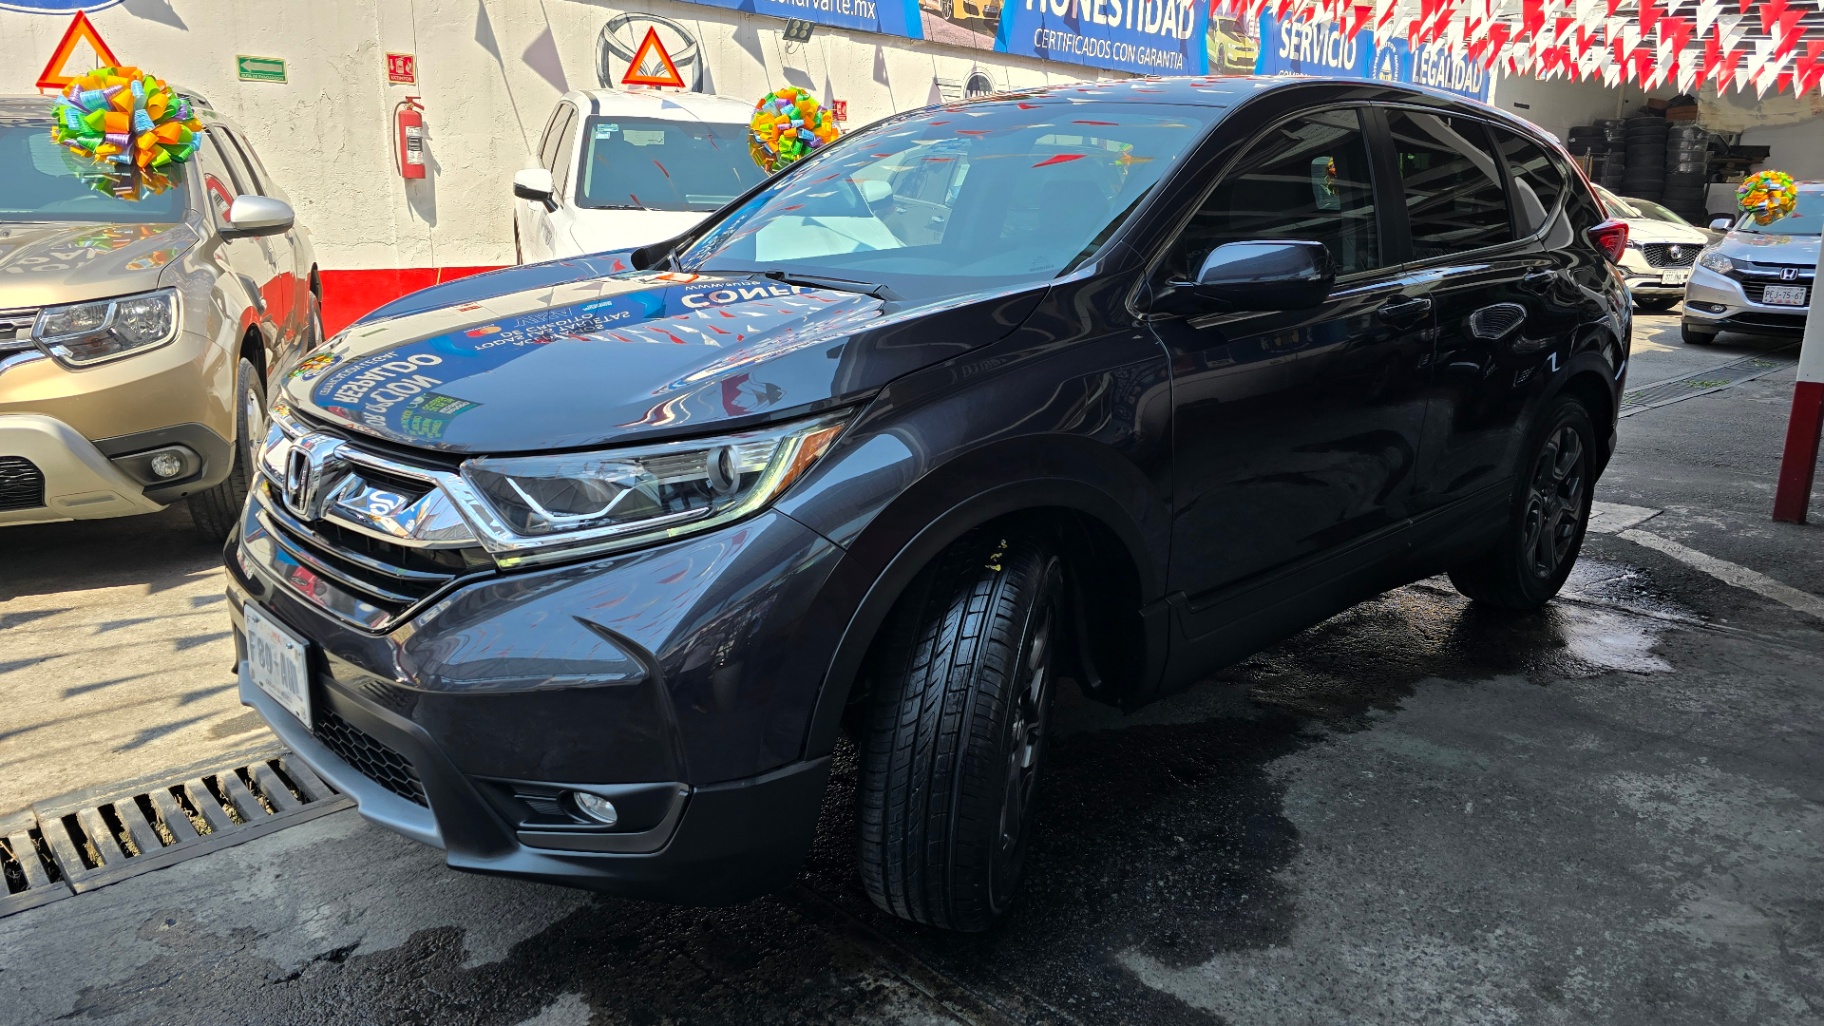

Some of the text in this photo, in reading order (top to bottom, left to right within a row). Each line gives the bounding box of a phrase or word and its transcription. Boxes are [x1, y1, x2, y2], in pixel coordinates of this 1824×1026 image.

[1025, 0, 1195, 39] NESTIDAD
[1034, 28, 1183, 70] CERTIFICADOS CON GARANTIA
[1279, 20, 1357, 70] SERVICIO
[1412, 49, 1483, 93] LEGALIDAD
